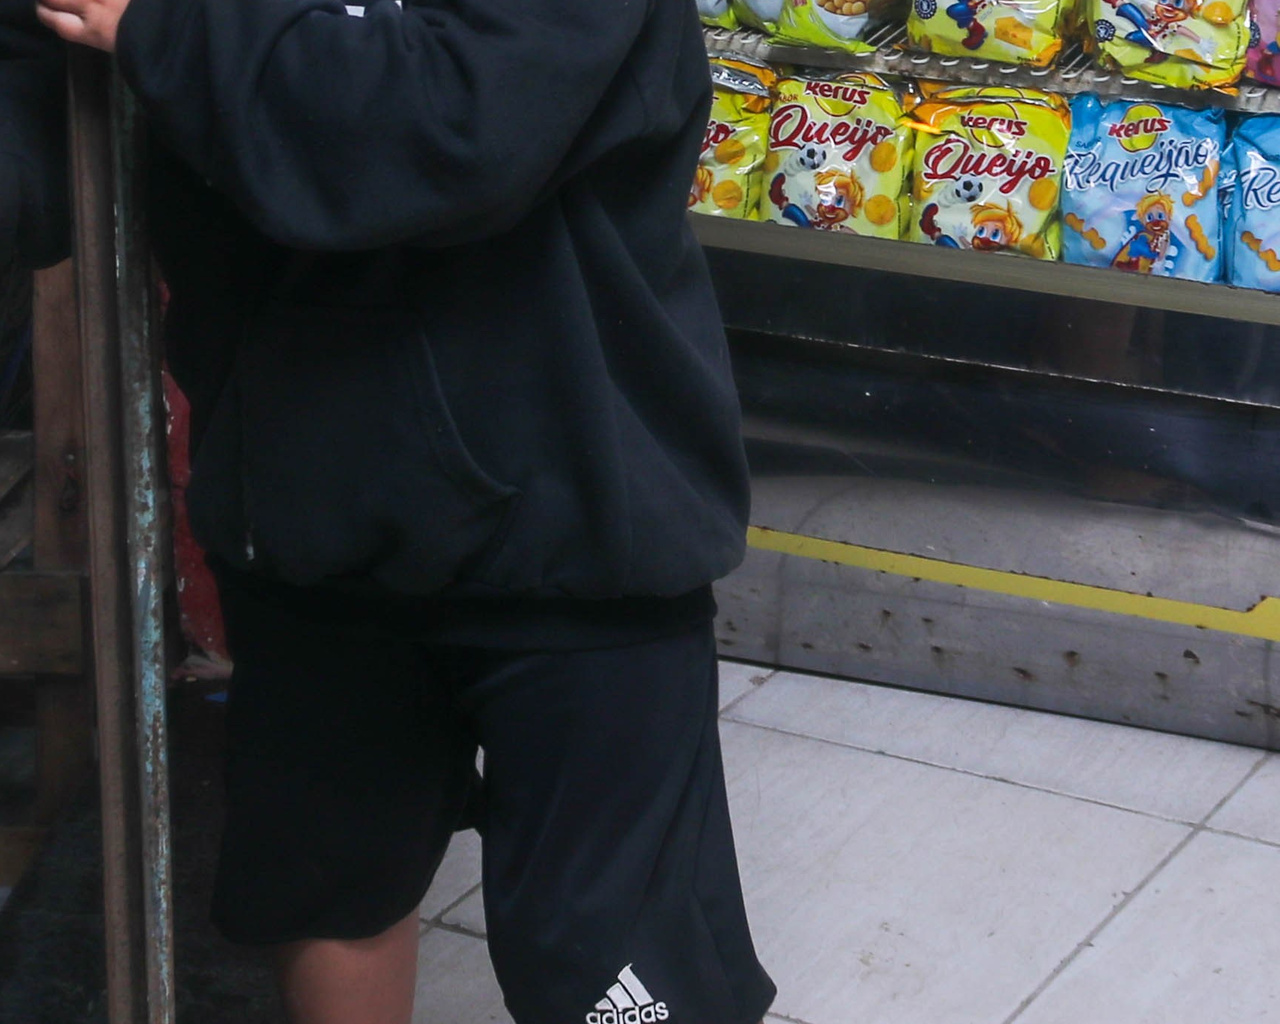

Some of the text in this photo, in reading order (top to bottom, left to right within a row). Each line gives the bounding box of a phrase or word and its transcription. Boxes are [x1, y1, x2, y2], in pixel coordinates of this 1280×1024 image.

[770, 104, 894, 161] Queijo
[924, 138, 1056, 193] Queijo
[1065, 138, 1218, 193] Requeijão
[586, 1001, 670, 1024] adidas
